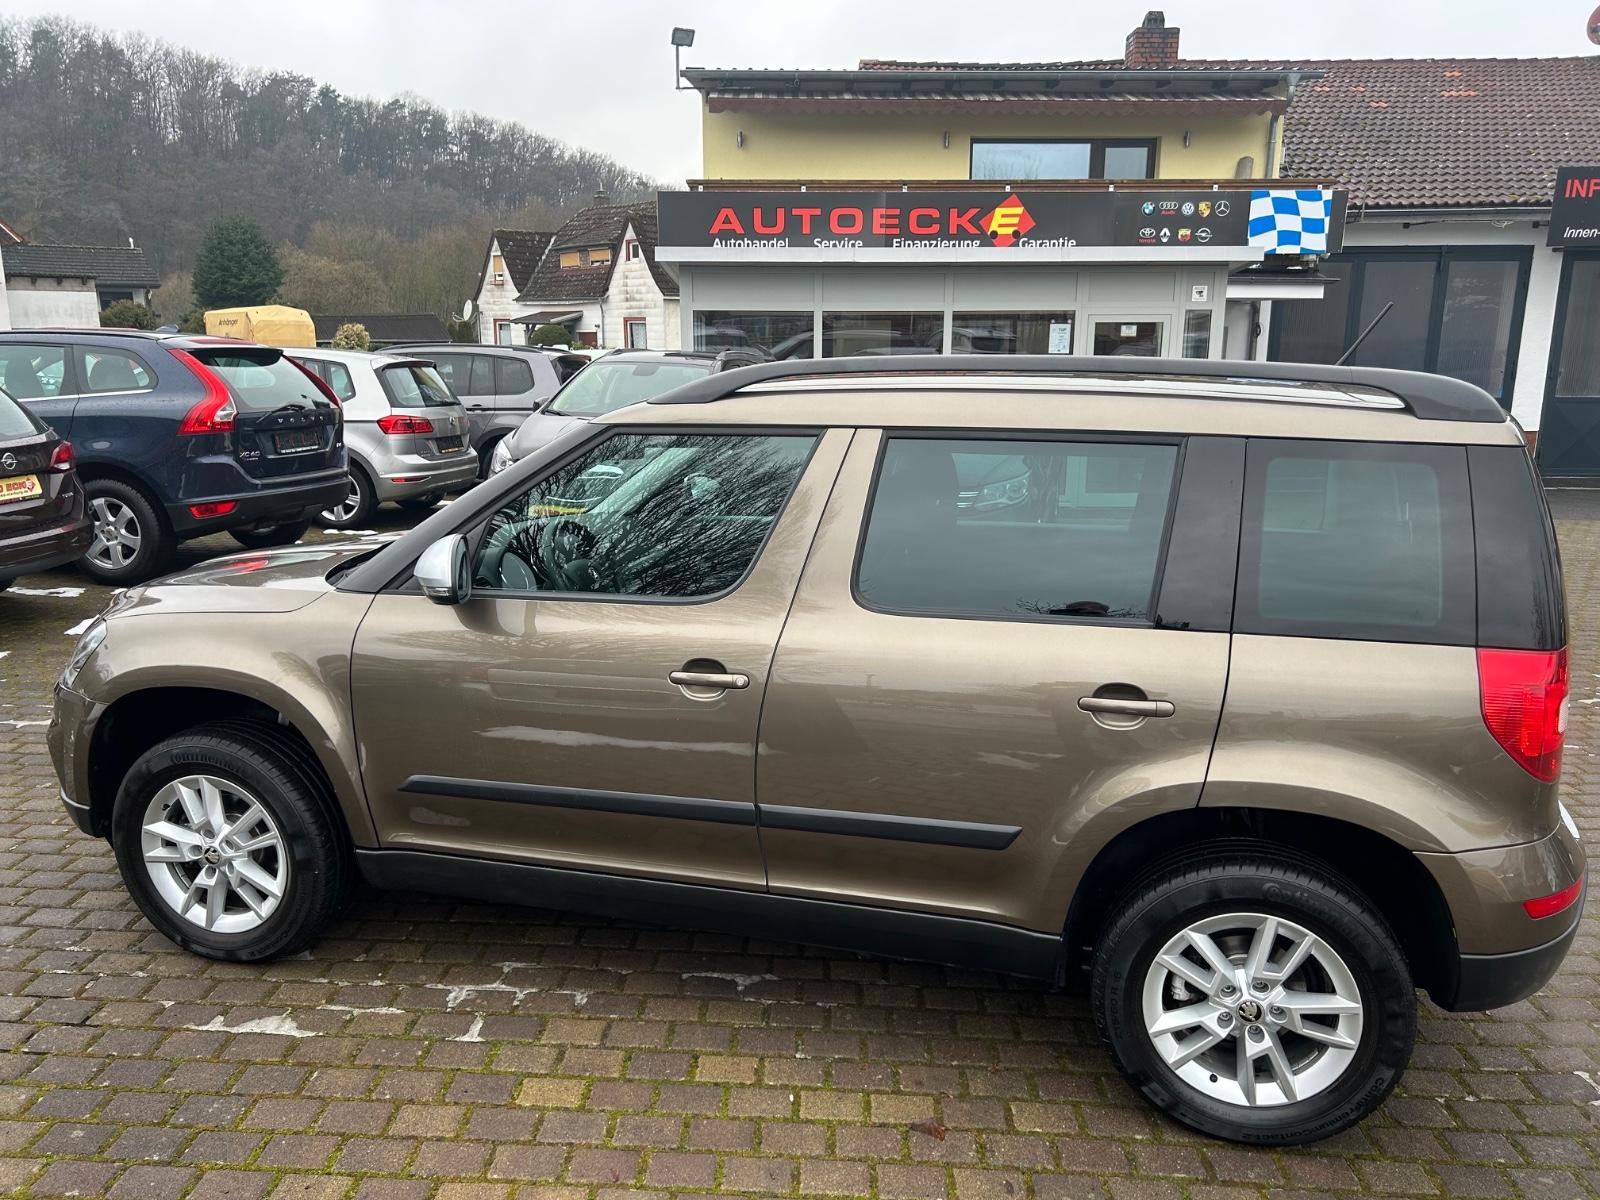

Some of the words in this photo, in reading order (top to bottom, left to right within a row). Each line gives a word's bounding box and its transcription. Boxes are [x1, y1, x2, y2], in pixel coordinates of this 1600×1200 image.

[713, 238, 789, 247] Autohandel
[813, 238, 863, 247] Service
[892, 238, 980, 247] Finanzierung
[1019, 237, 1076, 247] Garantie
[240, 450, 261, 458] XC60
